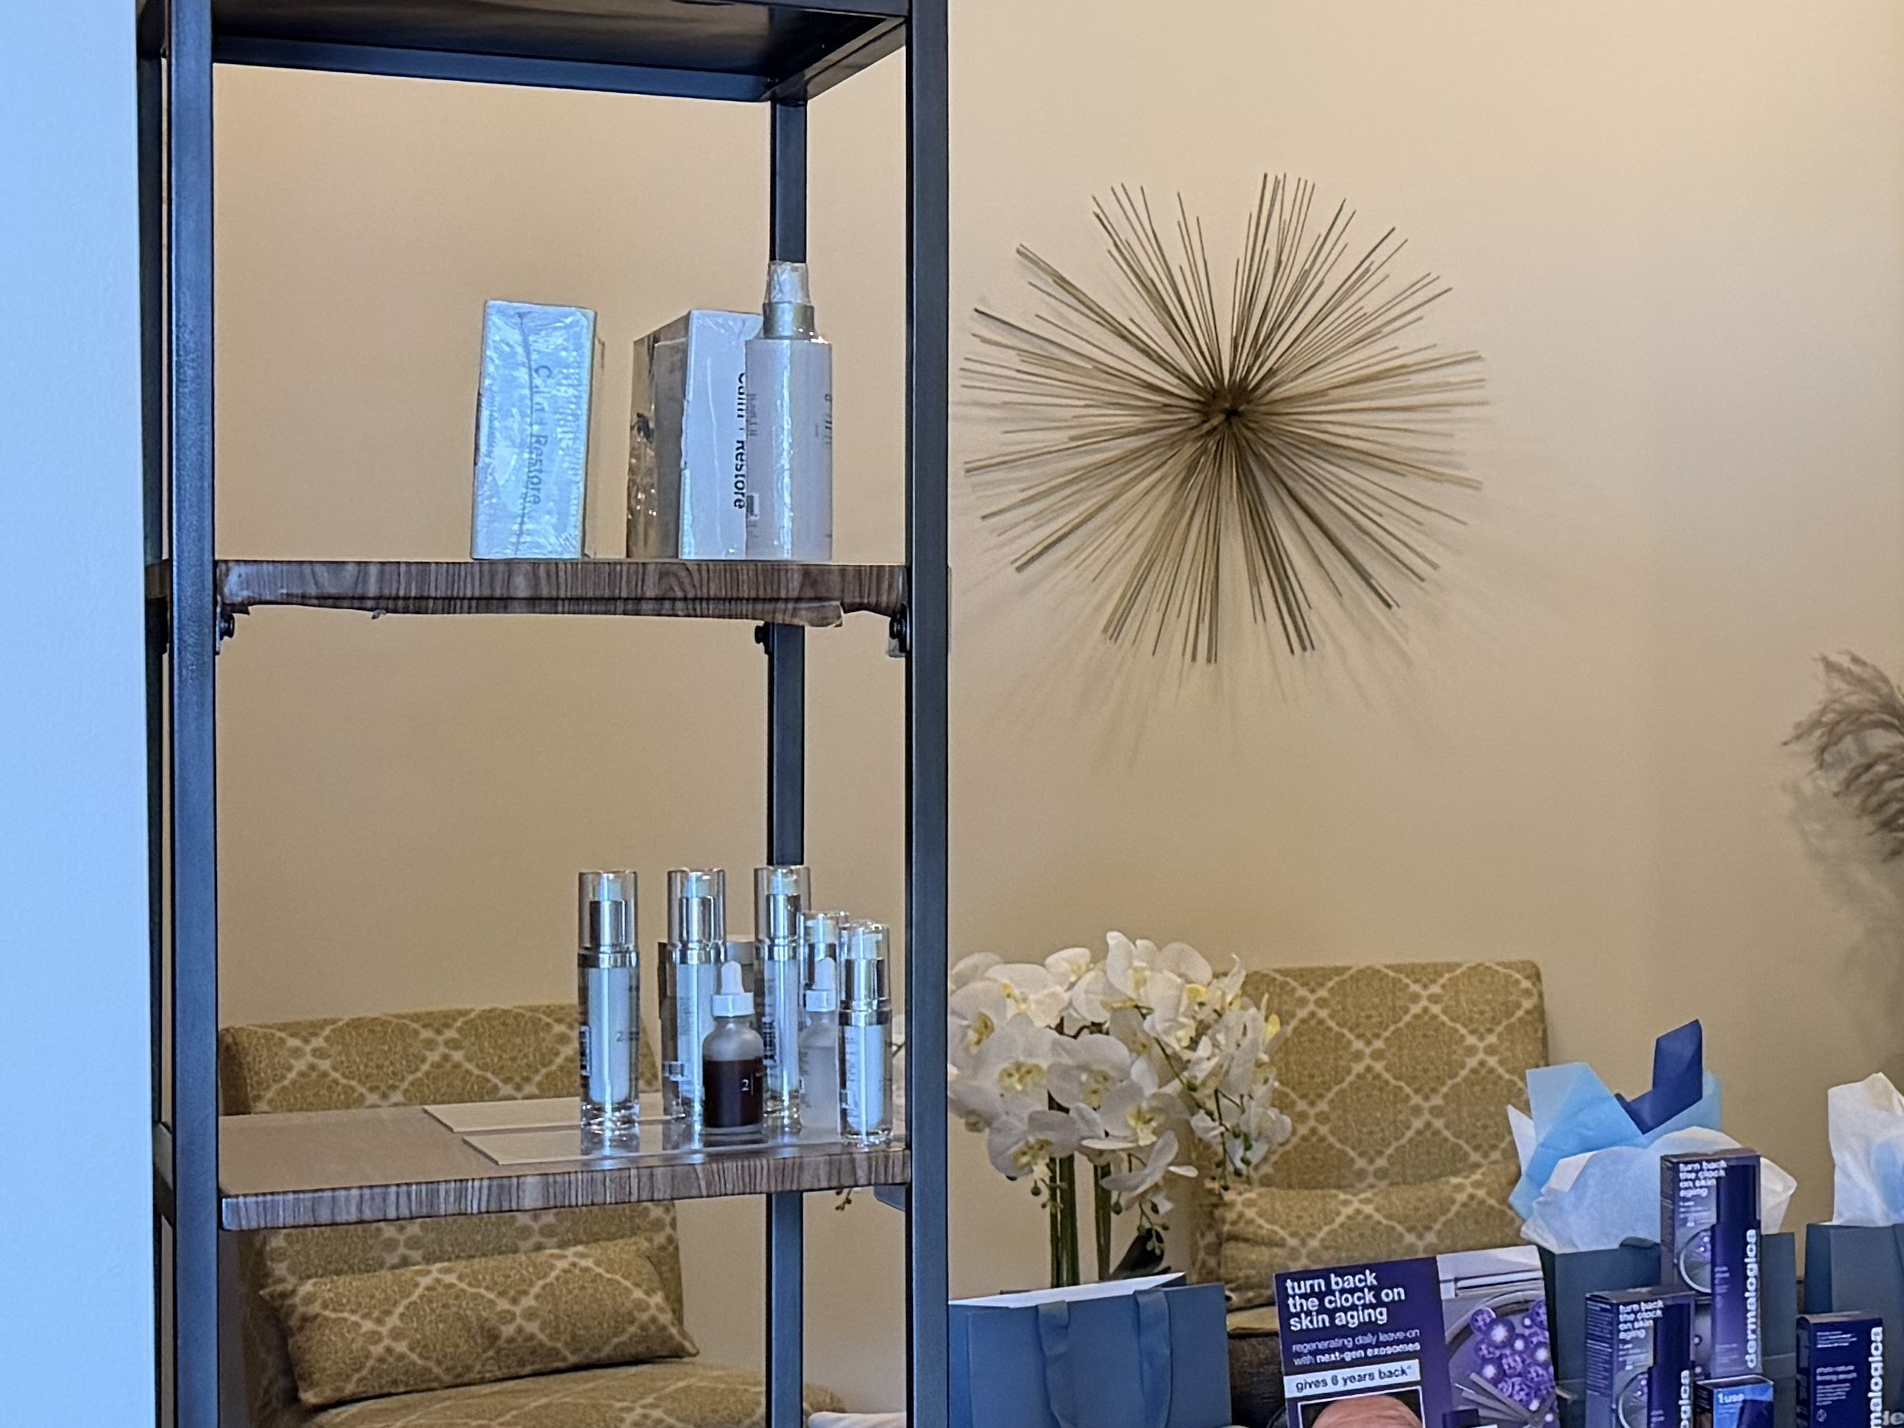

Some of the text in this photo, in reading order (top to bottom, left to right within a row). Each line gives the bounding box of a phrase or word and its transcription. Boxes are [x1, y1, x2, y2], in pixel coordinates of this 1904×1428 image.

[1285, 1269, 1378, 1295] turn back
[1287, 1285, 1406, 1313] the clock on
[1744, 1228, 1758, 1369] dermalogica
[1289, 1305, 1388, 1332] skin aging
[1291, 1335, 1352, 1354] regenerating
[1354, 1331, 1378, 1347] daily
[1292, 1341, 1421, 1366] with next-gen exosomes
[1295, 1376, 1328, 1392] gives
[1342, 1371, 1376, 1389] years
